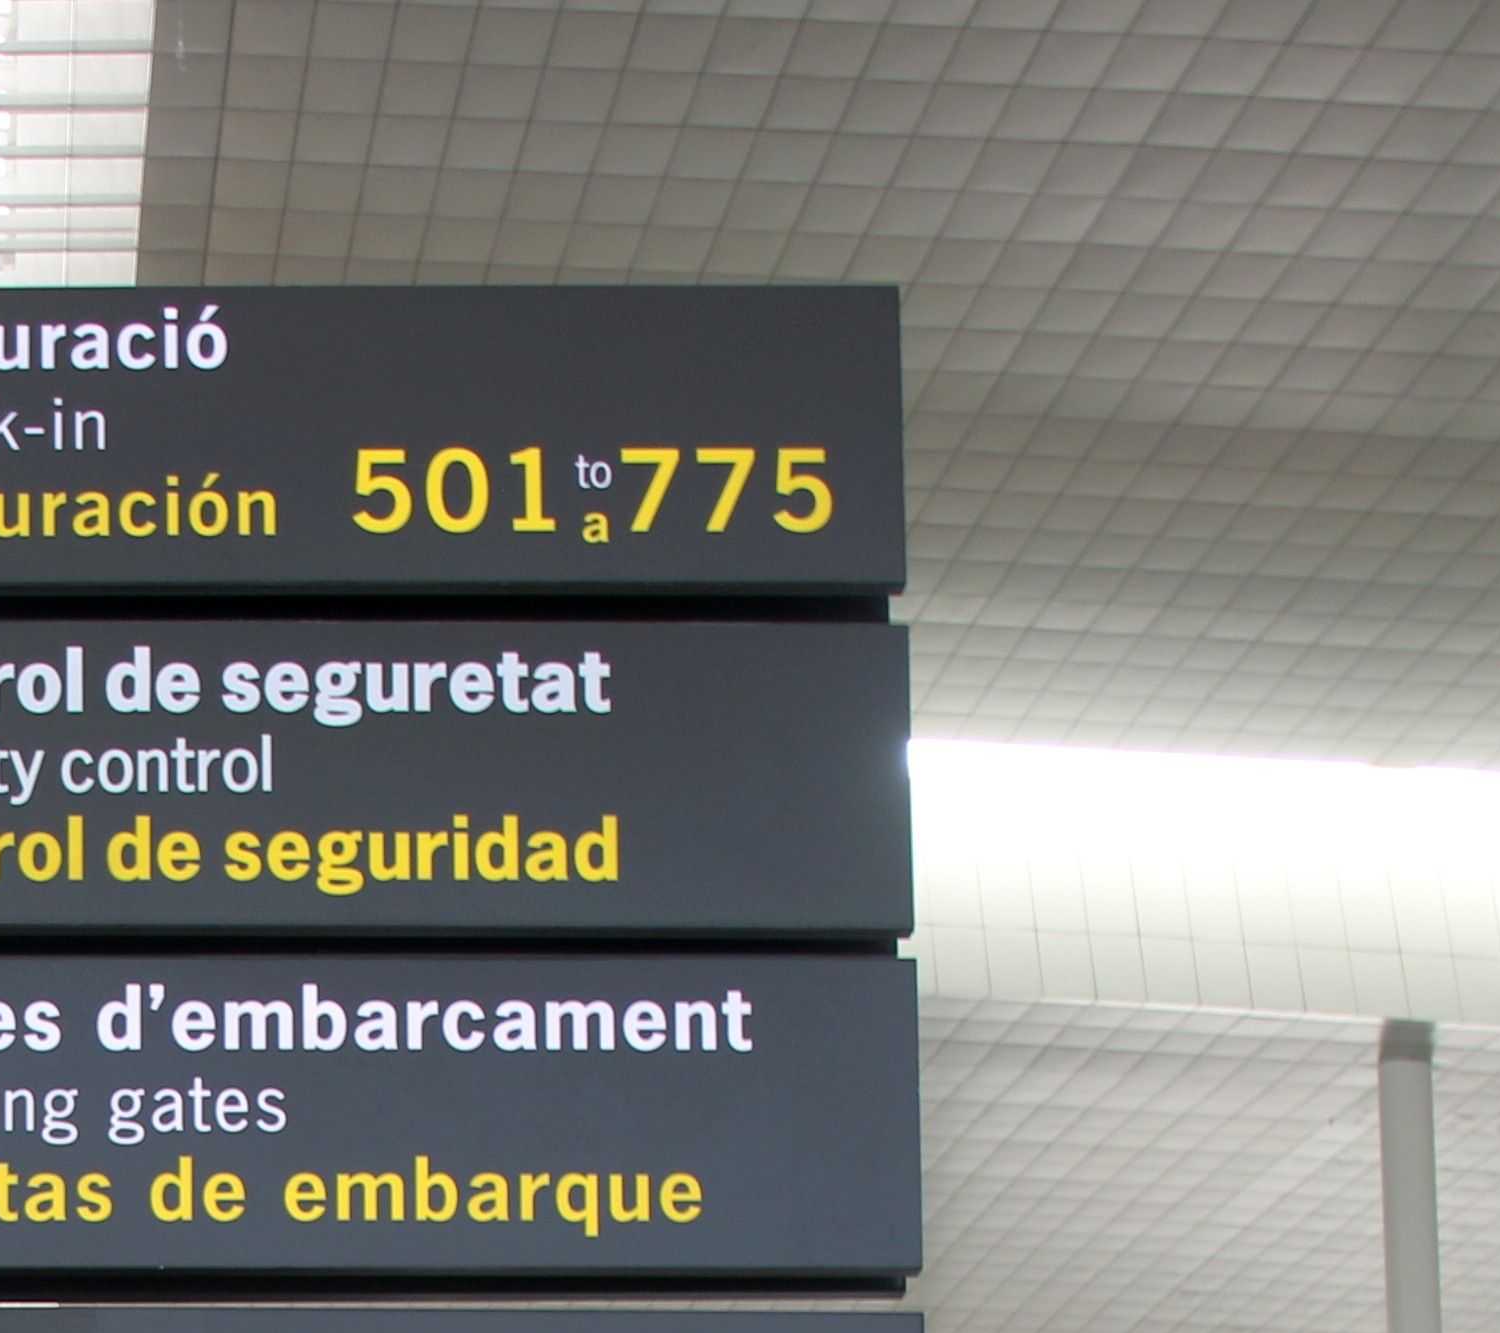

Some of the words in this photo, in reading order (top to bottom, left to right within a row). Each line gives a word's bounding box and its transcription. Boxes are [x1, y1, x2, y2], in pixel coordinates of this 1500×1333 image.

[353, 447, 555, 533] 501
[575, 455, 611, 488] to
[621, 448, 832, 532] 775
[583, 512, 608, 543] a
[105, 646, 200, 713] de
[222, 652, 610, 726] seguretat
[61, 734, 272, 793] control
[107, 815, 200, 881] de
[225, 814, 618, 895] seguridad
[96, 983, 752, 1051] d'embarcament
[108, 1077, 286, 1146] gates
[151, 1156, 245, 1221] de
[284, 1155, 701, 1239] embarque
